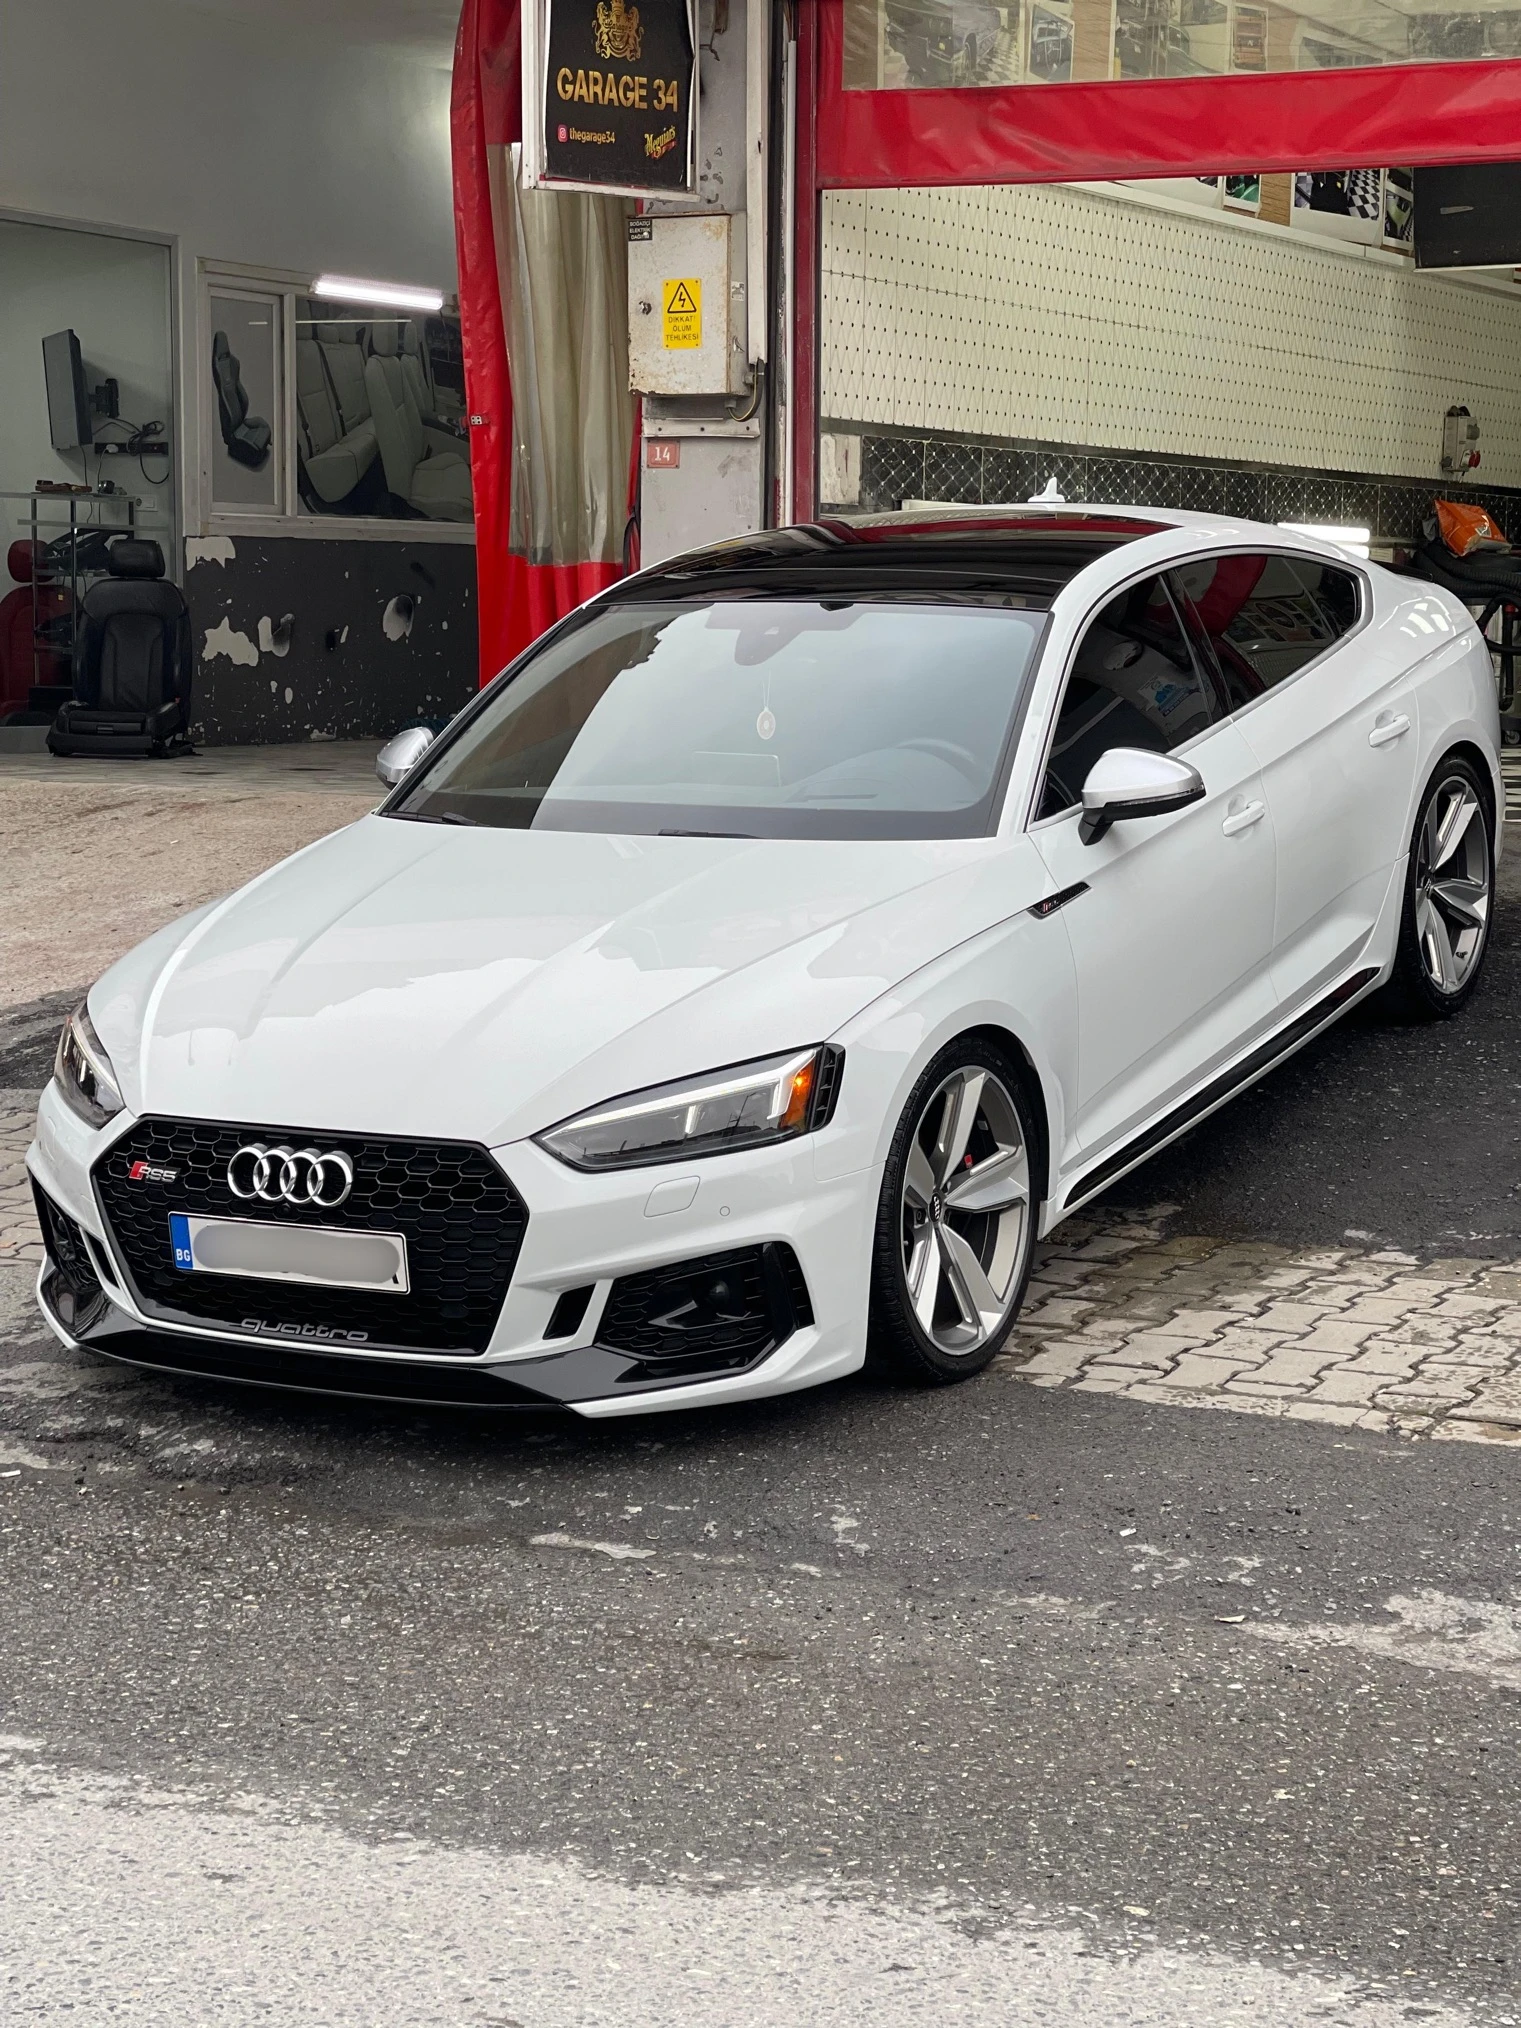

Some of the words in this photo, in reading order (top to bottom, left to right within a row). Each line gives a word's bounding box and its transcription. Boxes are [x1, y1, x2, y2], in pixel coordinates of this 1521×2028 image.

[557, 67, 648, 109] GARAGE
[653, 79, 678, 112] 34
[569, 127, 616, 145] thegarage34
[654, 446, 670, 462] 14
[137, 1164, 178, 1183] RS5
[175, 1248, 191, 1262] BG
[240, 1318, 369, 1342] quattro
